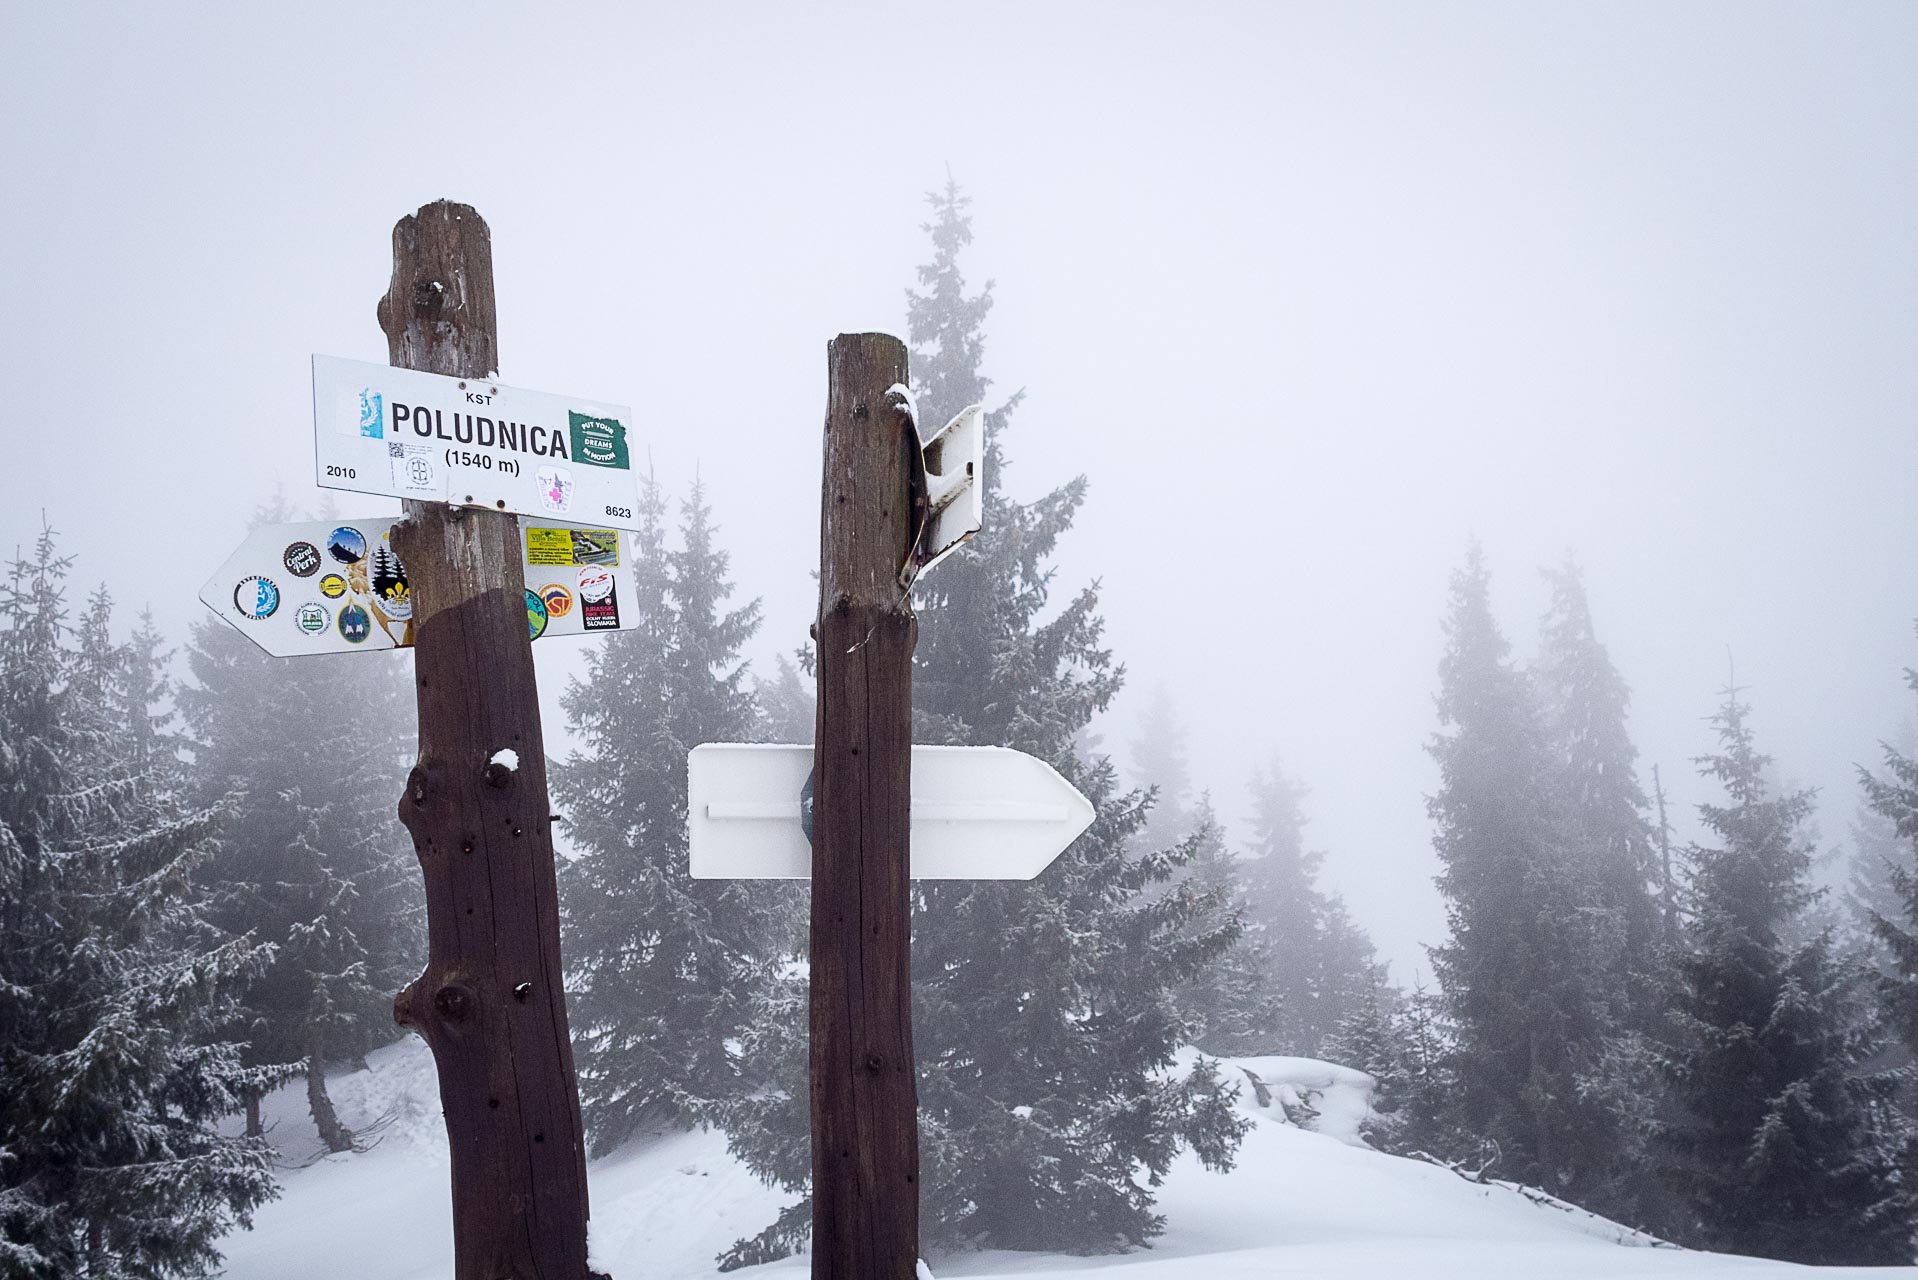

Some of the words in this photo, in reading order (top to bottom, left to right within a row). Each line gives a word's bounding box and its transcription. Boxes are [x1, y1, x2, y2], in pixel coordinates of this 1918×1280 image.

[466, 392, 492, 406] KST
[392, 402, 568, 460] POLUDNICA
[581, 421, 594, 430] PUT
[595, 422, 614, 435] YOUR
[584, 438, 613, 449] DREAMS
[582, 447, 591, 456] IN
[590, 451, 616, 461] MOTION
[445, 449, 492, 470] (1540
[498, 457, 520, 478] m)
[326, 465, 356, 479] 2010
[605, 505, 632, 519] 8623
[286, 545, 313, 567] Central
[293, 555, 318, 573] Perk
